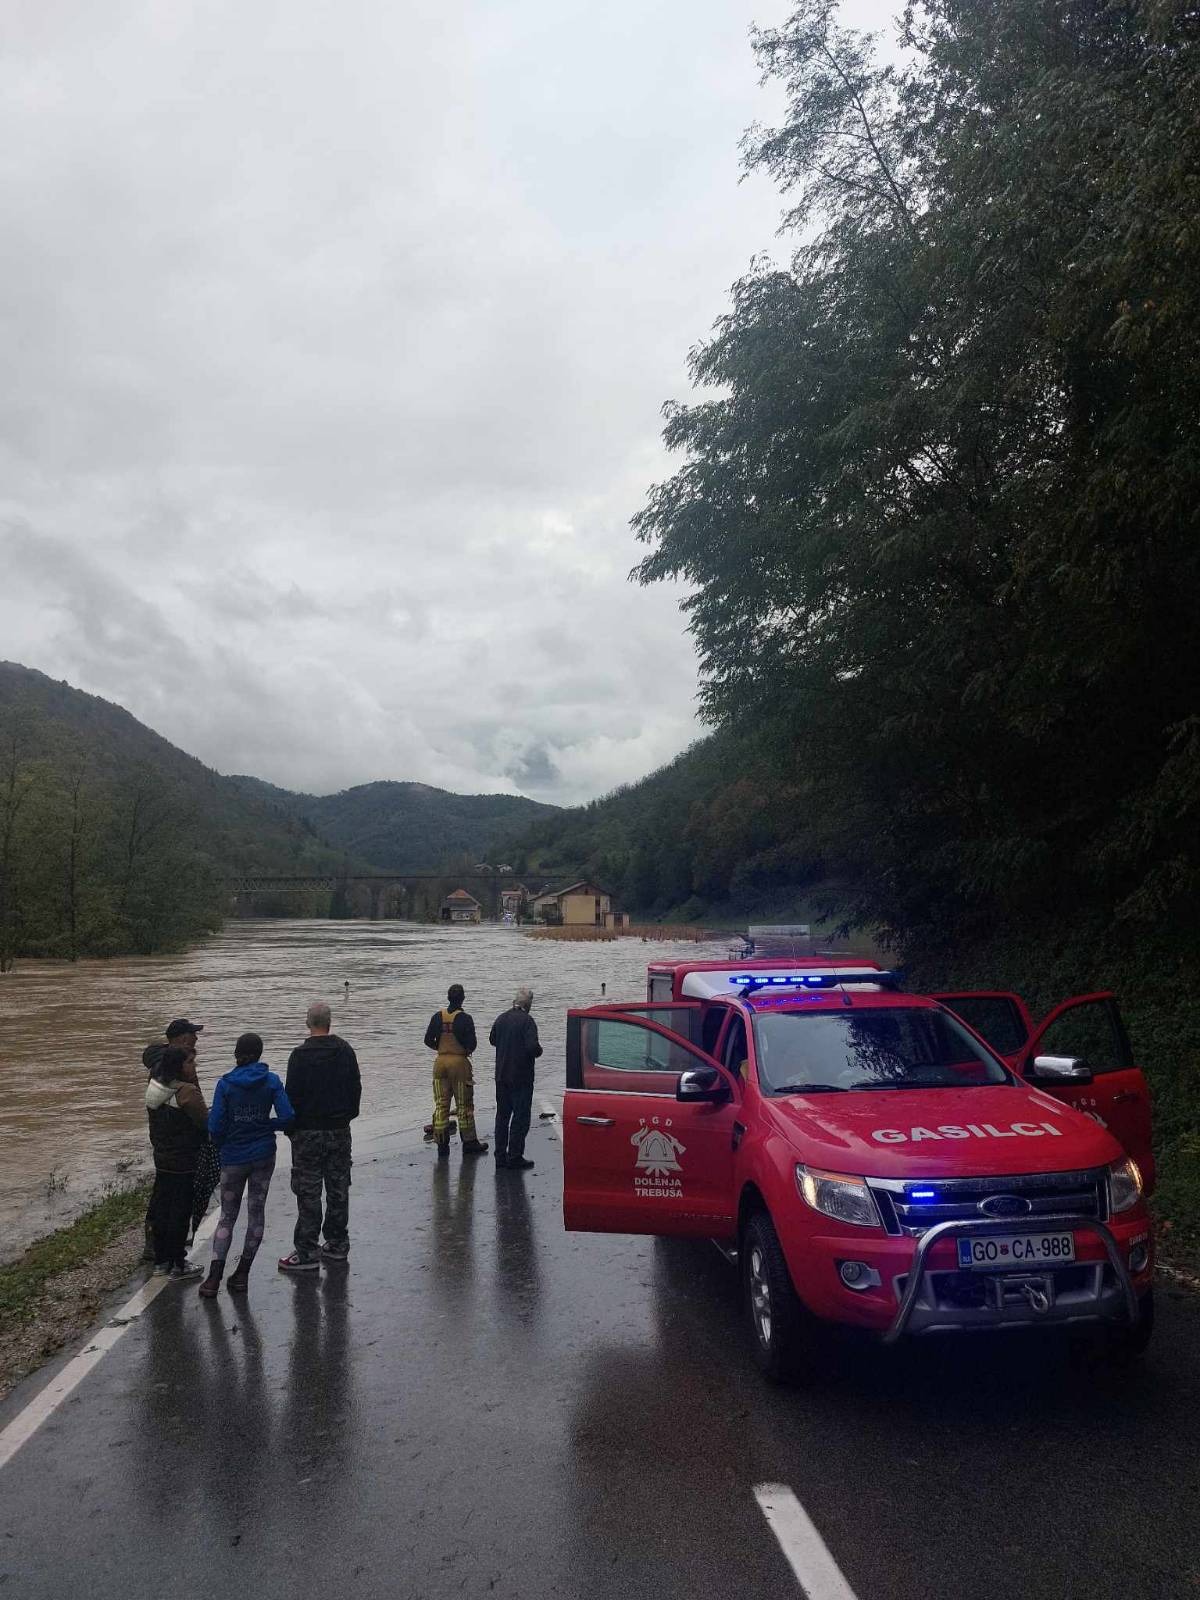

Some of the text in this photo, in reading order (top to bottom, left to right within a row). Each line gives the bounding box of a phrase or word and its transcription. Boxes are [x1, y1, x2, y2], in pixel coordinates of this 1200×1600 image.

[871, 1122, 1064, 1144] GASILCI
[634, 1177, 682, 1187] DOLENJA
[634, 1187, 684, 1198] TREBUŠA
[972, 1236, 1072, 1262] GO CA-988
